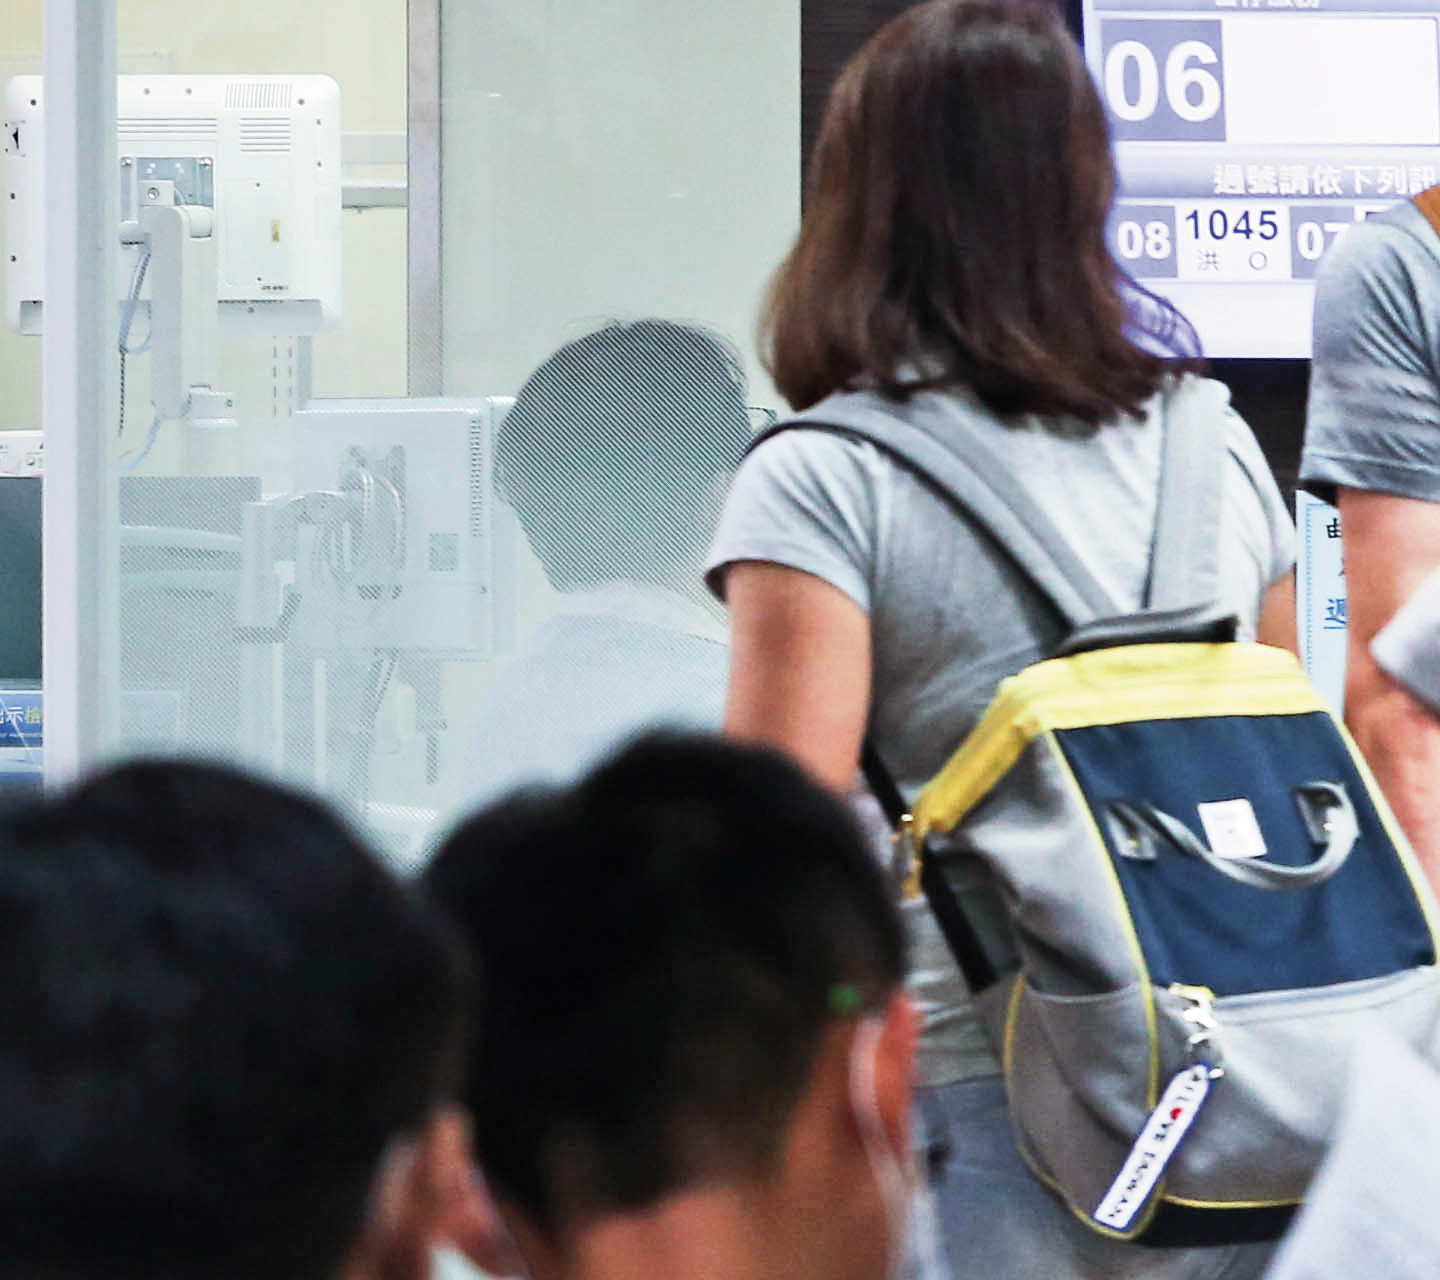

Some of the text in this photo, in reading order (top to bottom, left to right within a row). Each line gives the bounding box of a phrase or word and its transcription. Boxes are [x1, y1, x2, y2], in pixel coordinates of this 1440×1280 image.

[1104, 39, 1222, 124] 06
[1118, 220, 1172, 260] 08
[1186, 209, 1278, 240] 1045
